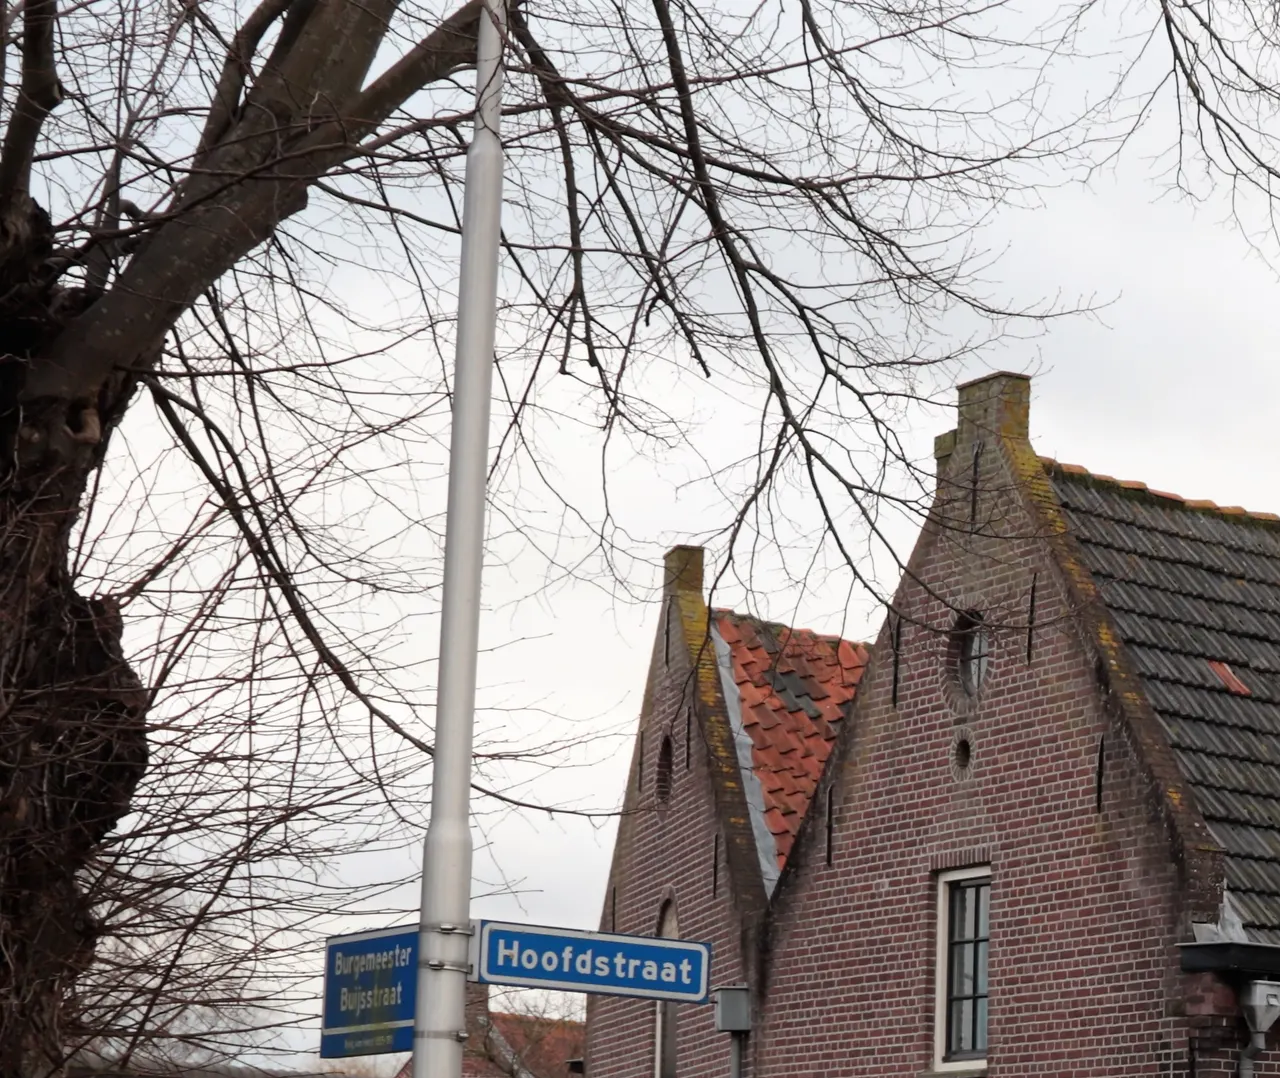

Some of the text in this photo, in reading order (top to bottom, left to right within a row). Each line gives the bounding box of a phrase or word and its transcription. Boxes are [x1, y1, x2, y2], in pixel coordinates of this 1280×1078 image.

[335, 944, 412, 980] Burgemeester
[497, 939, 692, 984] Hoofdstraat
[340, 981, 402, 1017] Buijsstraat
